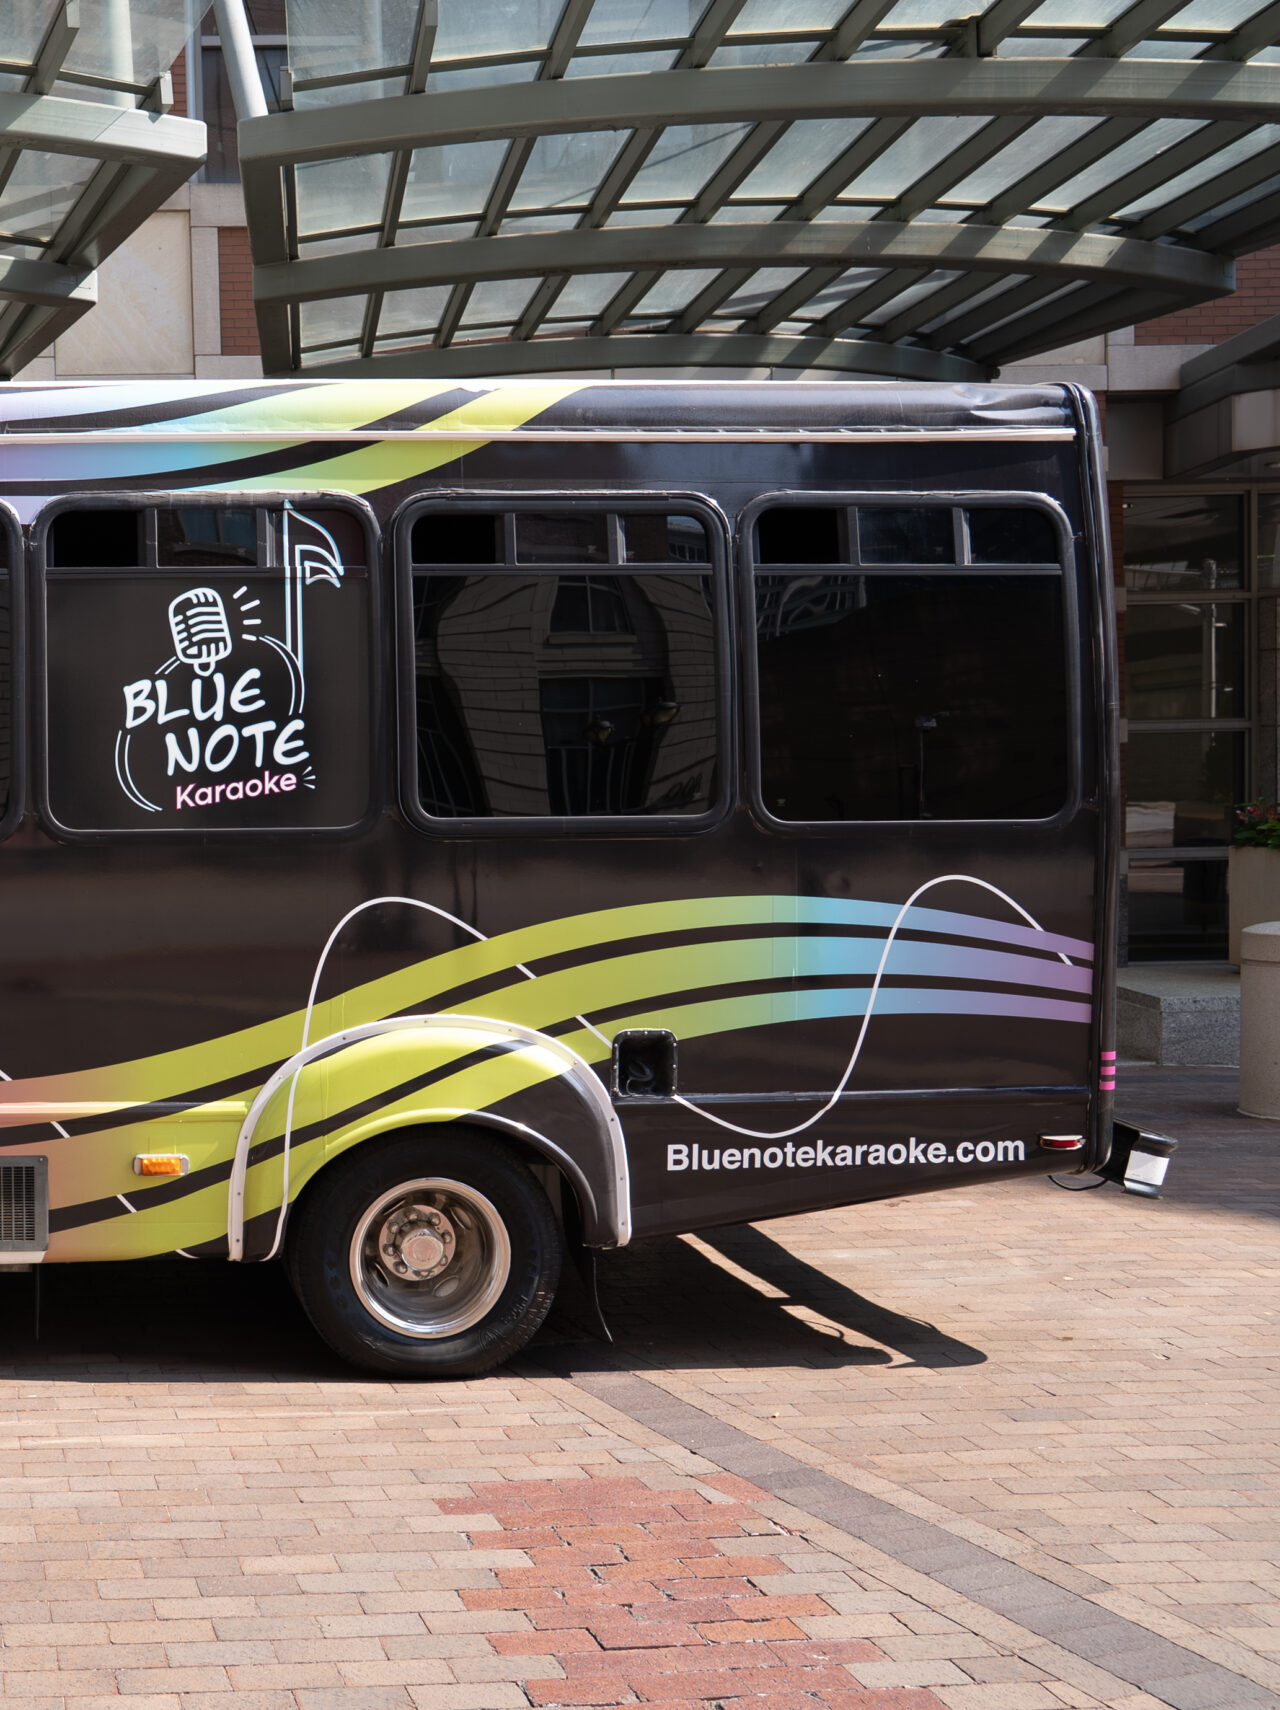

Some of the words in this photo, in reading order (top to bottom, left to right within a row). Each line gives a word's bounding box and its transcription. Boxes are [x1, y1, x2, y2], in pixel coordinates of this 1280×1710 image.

[123, 668, 266, 729] BLUE
[165, 719, 310, 776] NOTE
[176, 771, 297, 809] Karaoke
[667, 1137, 1025, 1171] Bluenotekaraoke.com
